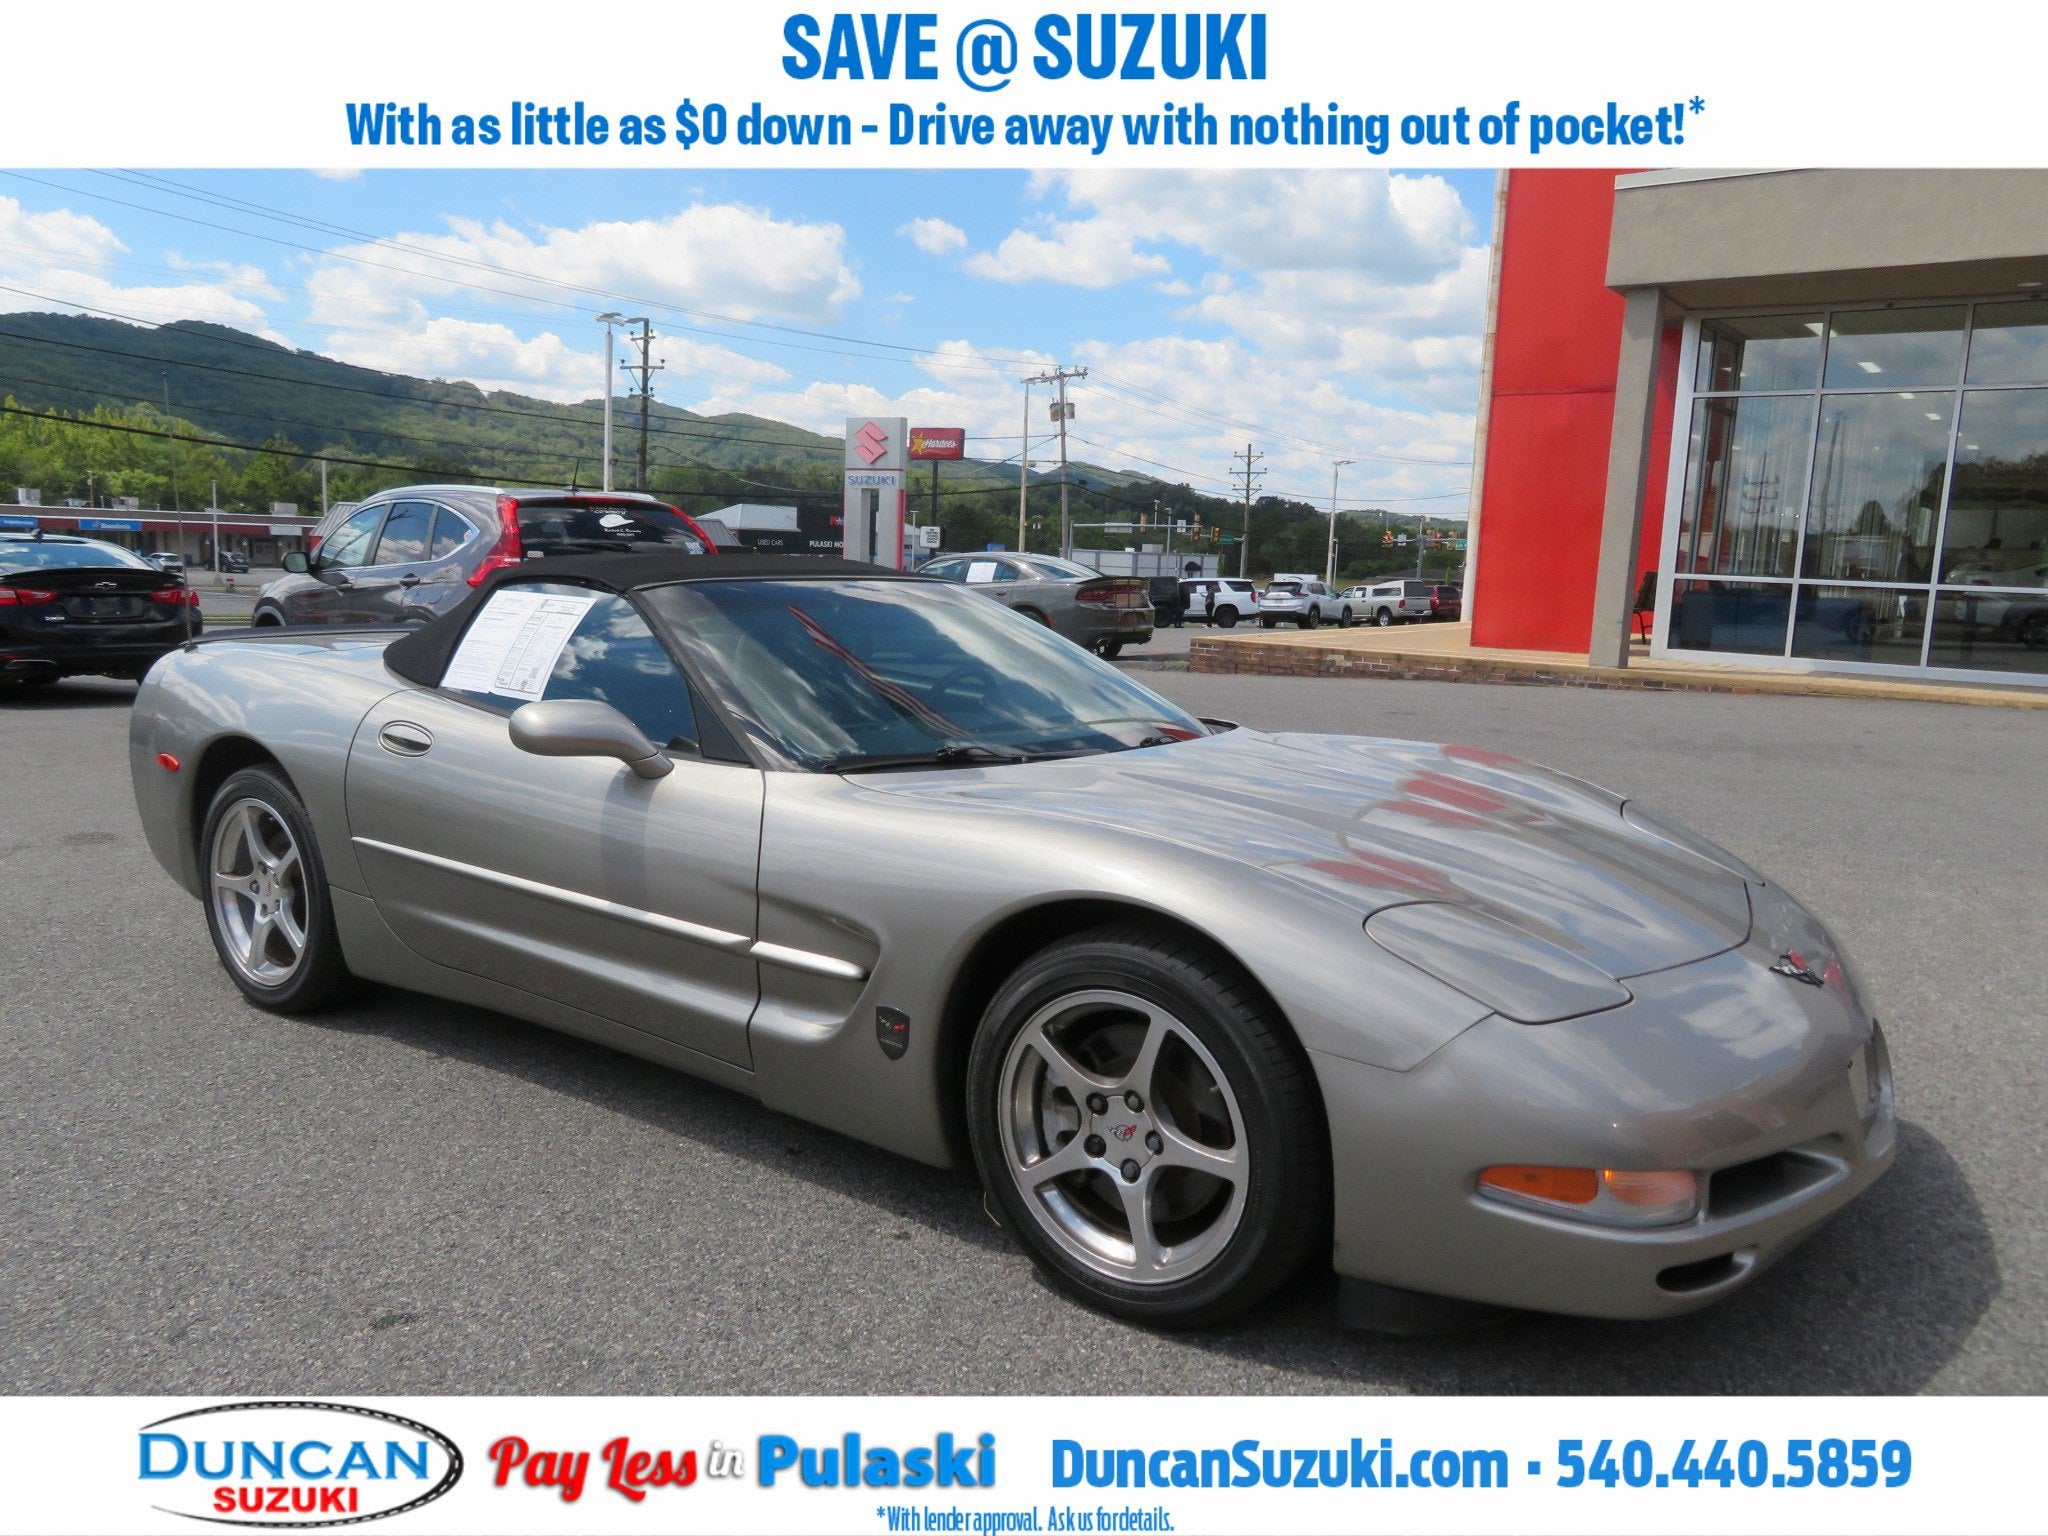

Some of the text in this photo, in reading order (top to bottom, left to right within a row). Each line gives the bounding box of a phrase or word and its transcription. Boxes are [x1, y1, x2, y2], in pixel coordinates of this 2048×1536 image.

[848, 475, 896, 486] SUZUKI
[757, 538, 770, 546] USED
[809, 540, 833, 548] PULASKI
